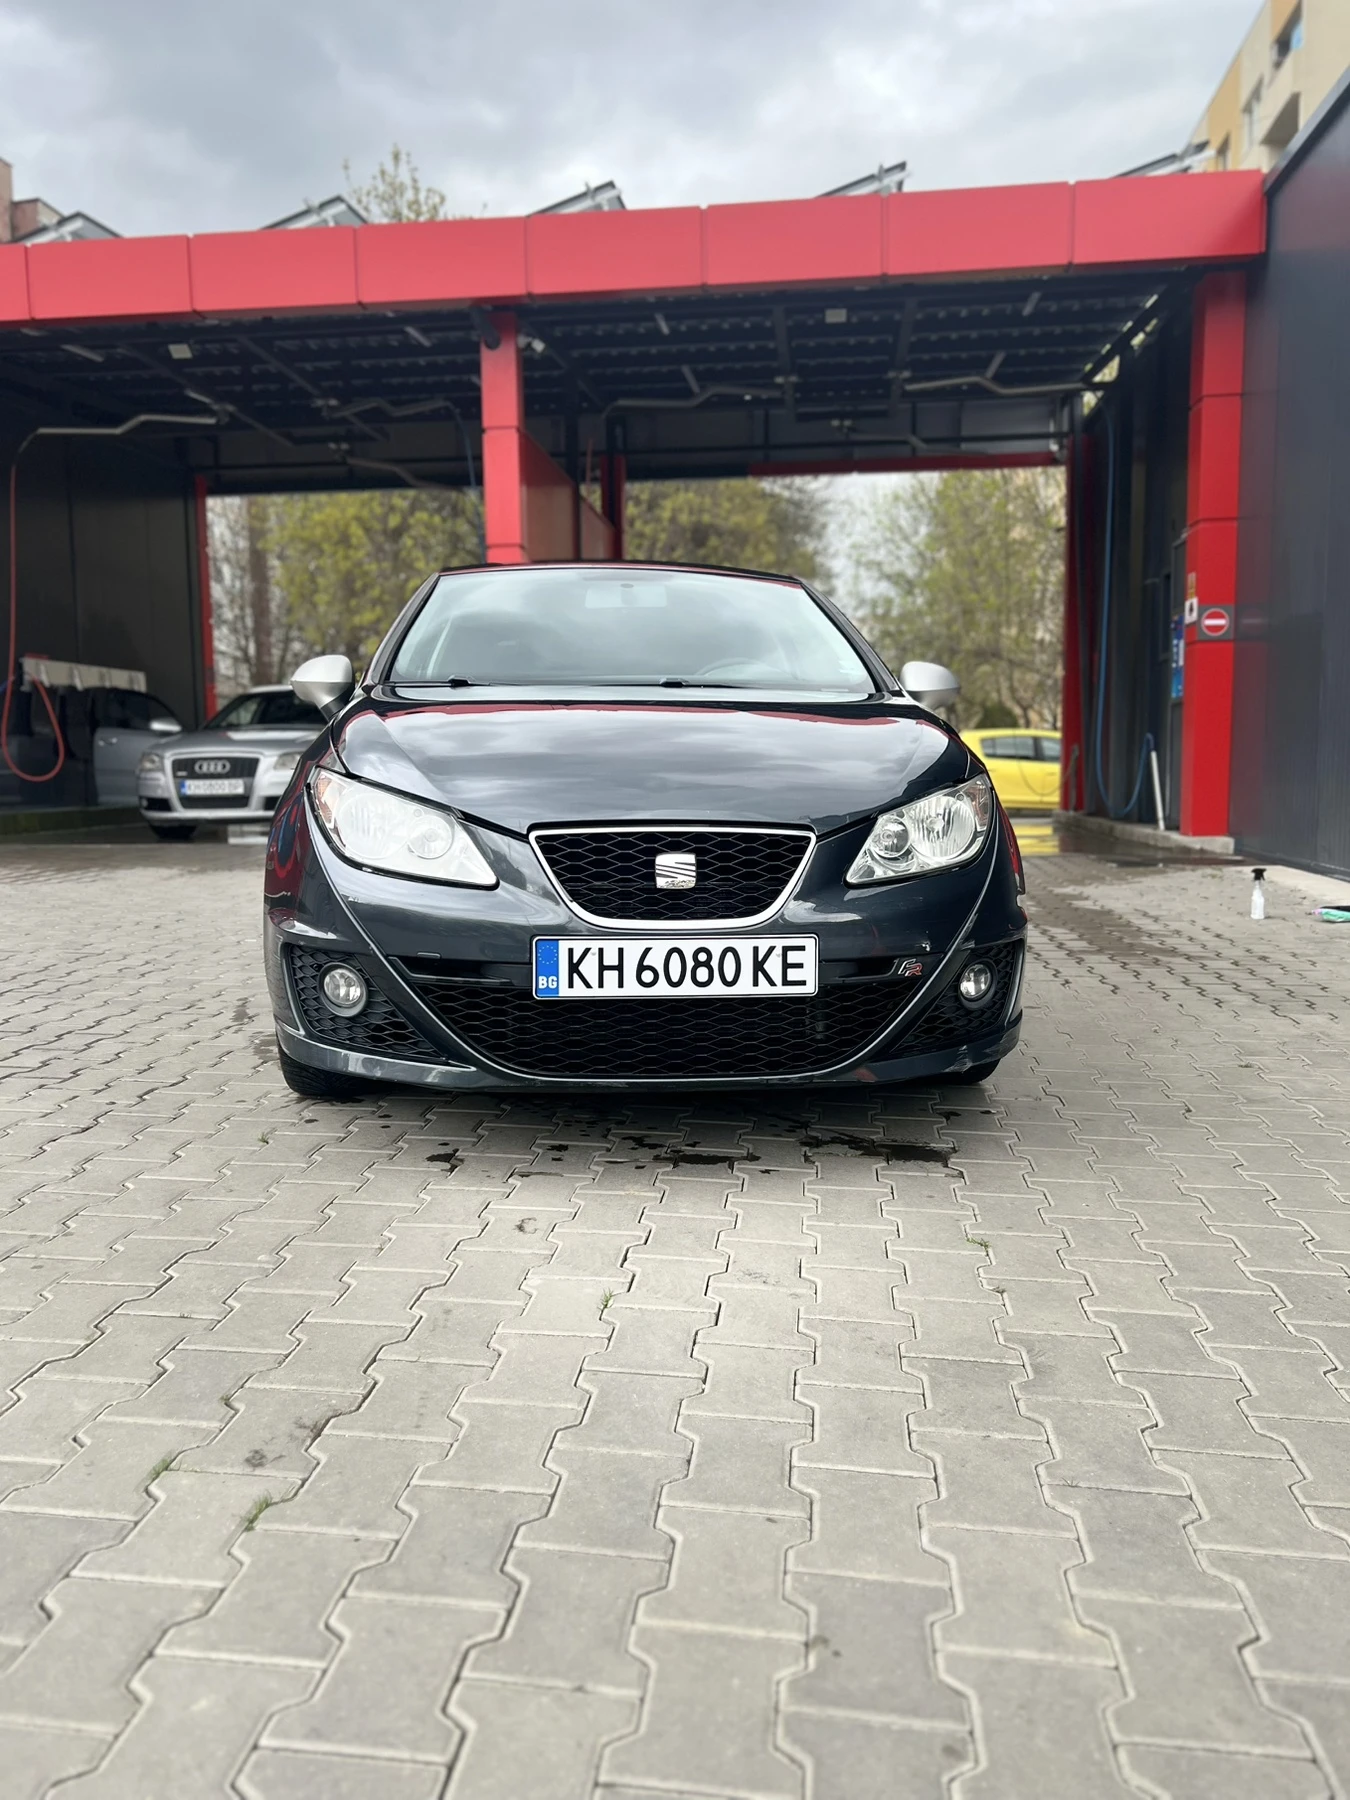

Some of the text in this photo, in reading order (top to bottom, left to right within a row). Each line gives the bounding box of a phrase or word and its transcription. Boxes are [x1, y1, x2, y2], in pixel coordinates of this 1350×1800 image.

[567, 945, 807, 989] KH 6080 KE
[897, 958, 923, 977] FR
[538, 976, 558, 989] BG
